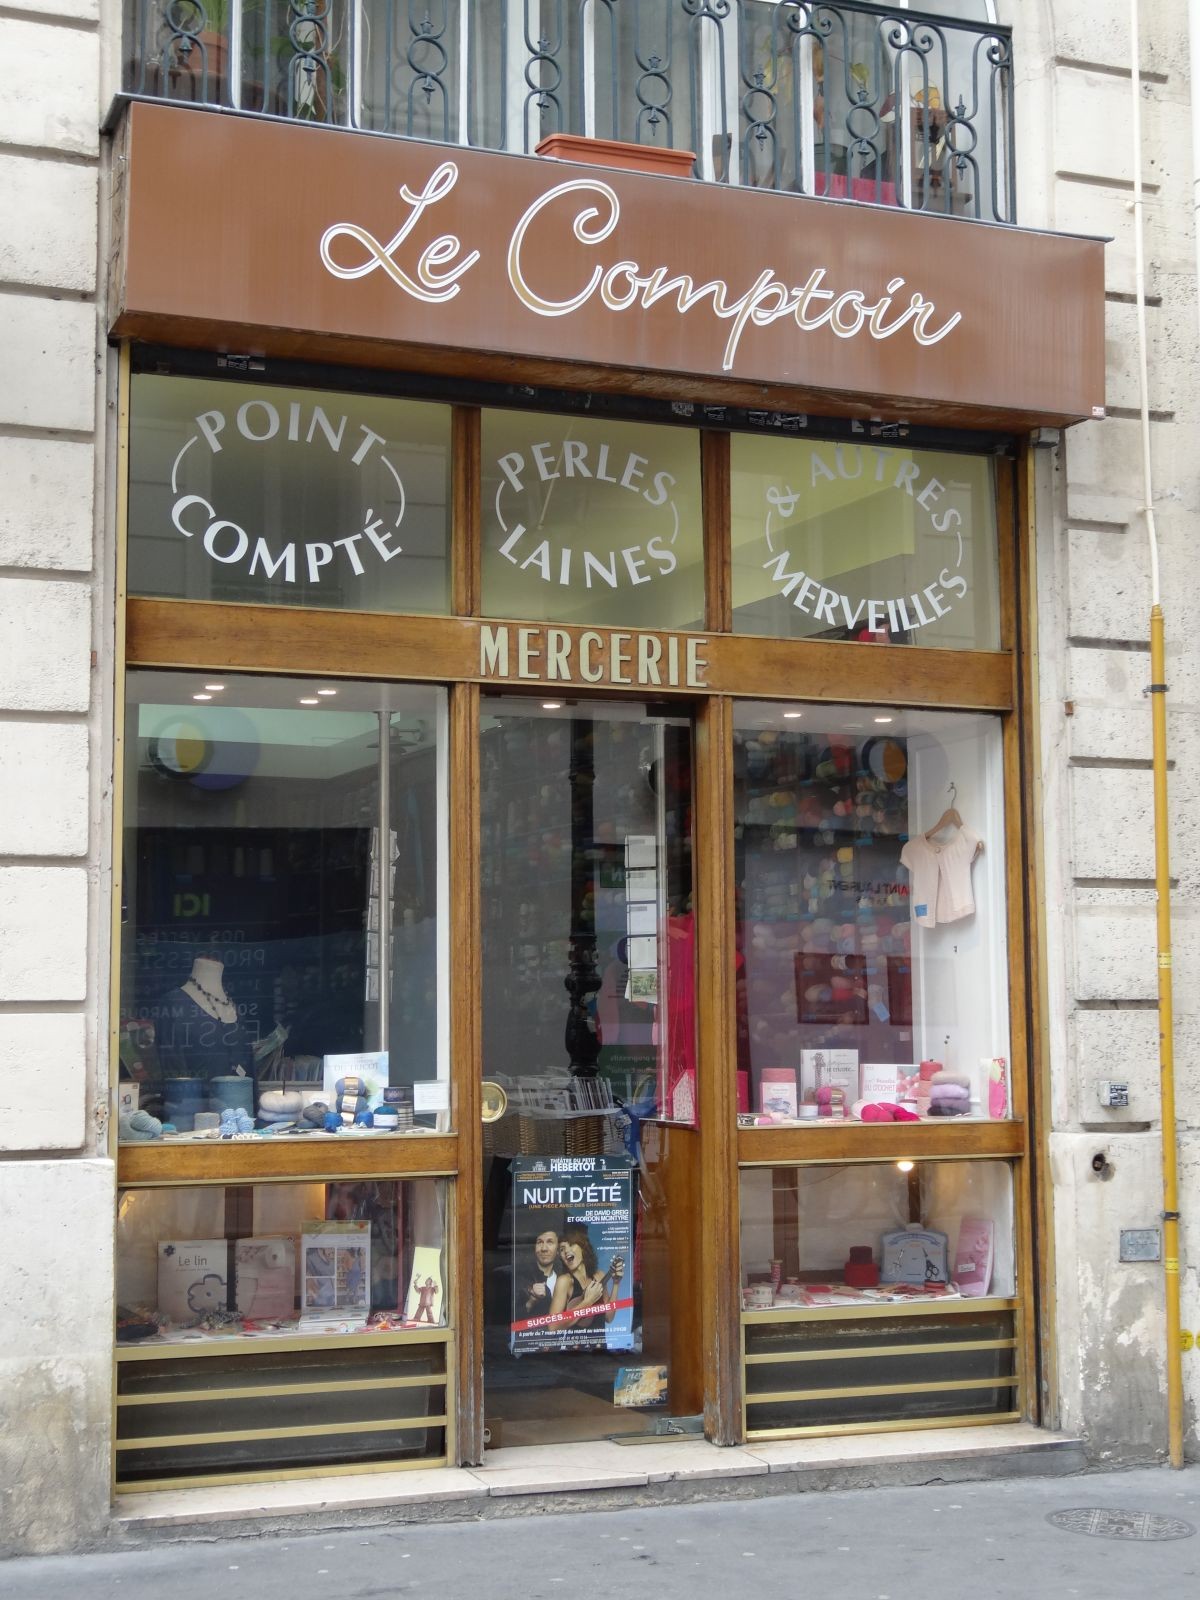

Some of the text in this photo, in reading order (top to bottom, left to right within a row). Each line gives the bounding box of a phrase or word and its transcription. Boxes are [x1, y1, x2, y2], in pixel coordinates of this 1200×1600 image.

[320, 161, 961, 371] Le Comptoir
[196, 400, 386, 466] POINT
[497, 440, 677, 506] PERLES
[766, 447, 962, 532] & AUTRES
[171, 495, 402, 583] COMPTÉ
[498, 524, 677, 588] LAINES
[762, 551, 968, 633] MERVEILLES
[480, 625, 708, 688] MERCERIE
[523, 1182, 622, 1204] NUIT D'ÉTÉ
[178, 1256, 191, 1266] Le
[574, 1304, 612, 1318] REPRISE
